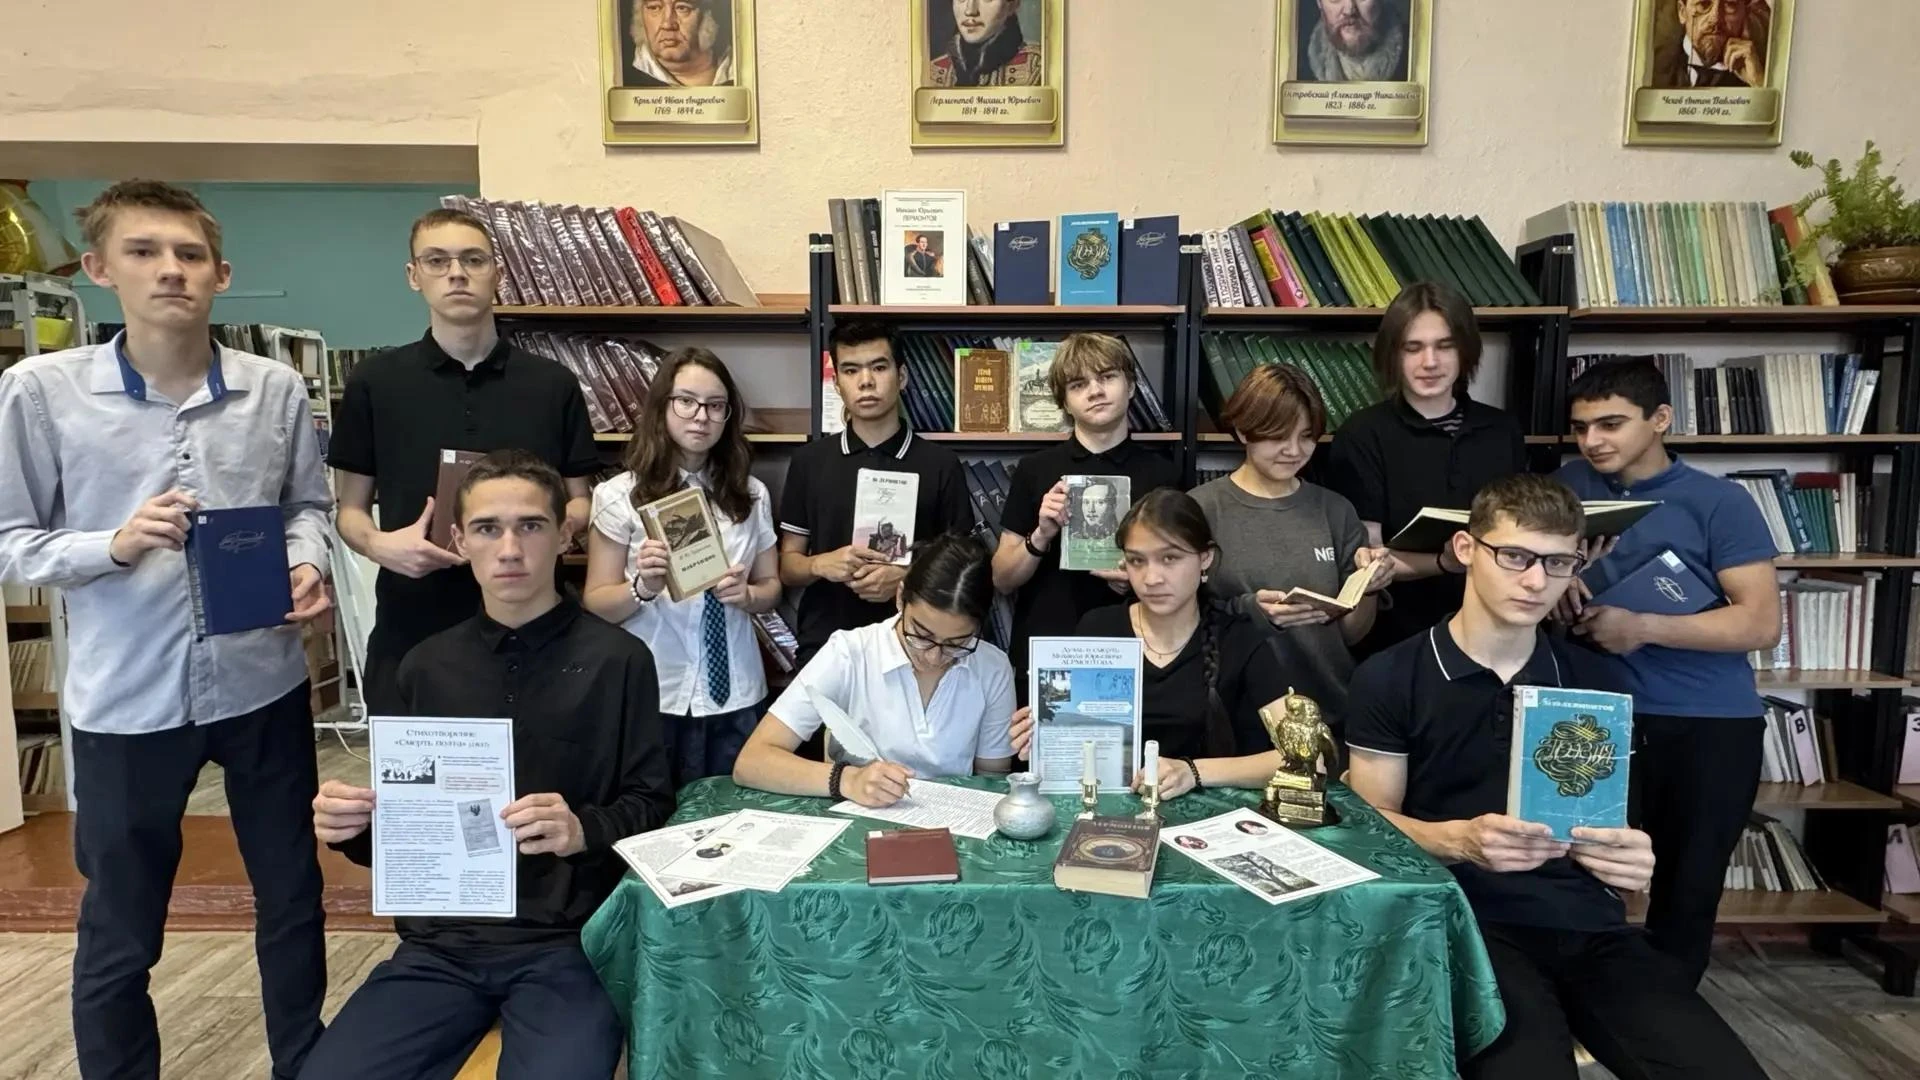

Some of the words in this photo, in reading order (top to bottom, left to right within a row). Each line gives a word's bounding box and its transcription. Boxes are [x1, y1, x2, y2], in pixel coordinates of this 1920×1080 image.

[1331, 91, 1372, 101] Александр
[1662, 96, 1683, 105] Чехов
[1685, 96, 1711, 105] Антон
[1713, 96, 1751, 105] Павлович
[633, 96, 662, 106] Крылов
[664, 96, 684, 105] Иван
[686, 96, 725, 106] Андреевич
[930, 96, 974, 106] Лермонтов
[976, 96, 1006, 105] Михаил
[1008, 96, 1042, 106] Юрьевич
[1325, 101, 1342, 110] 1823
[1348, 101, 1365, 110] 1886
[654, 106, 671, 115] 1769
[677, 106, 694, 115] 1844
[1678, 107, 1697, 116] 1860
[1702, 107, 1720, 116] 1904
